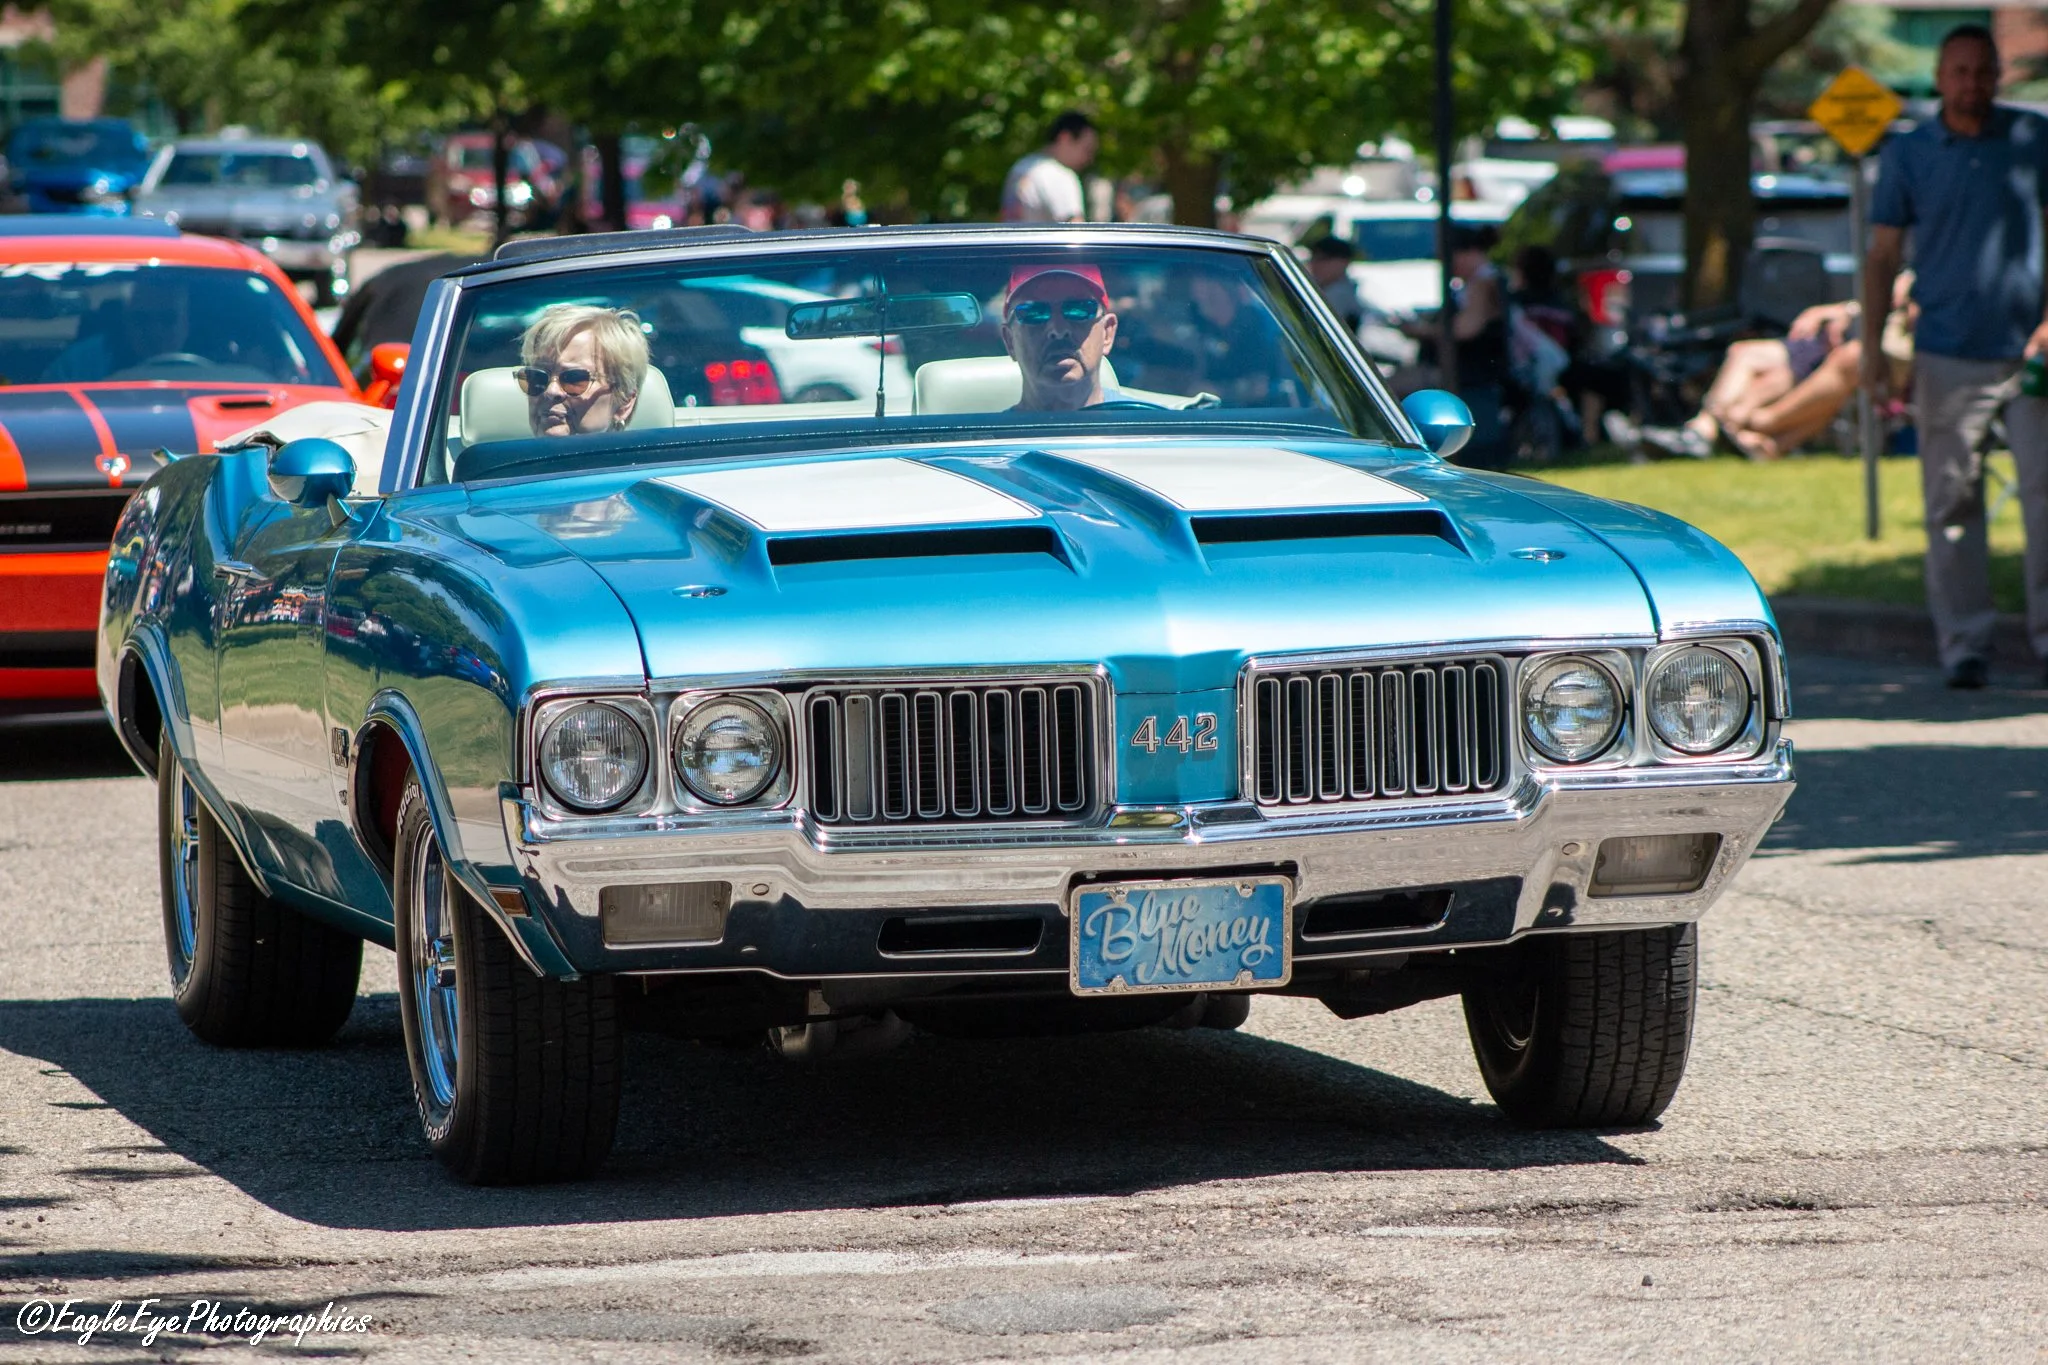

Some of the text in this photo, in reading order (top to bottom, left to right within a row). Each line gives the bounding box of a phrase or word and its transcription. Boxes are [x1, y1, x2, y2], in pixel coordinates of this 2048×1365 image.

[1131, 712, 1218, 754] 442
[1085, 891, 1200, 961] Blue
[1135, 915, 1274, 984] Money
